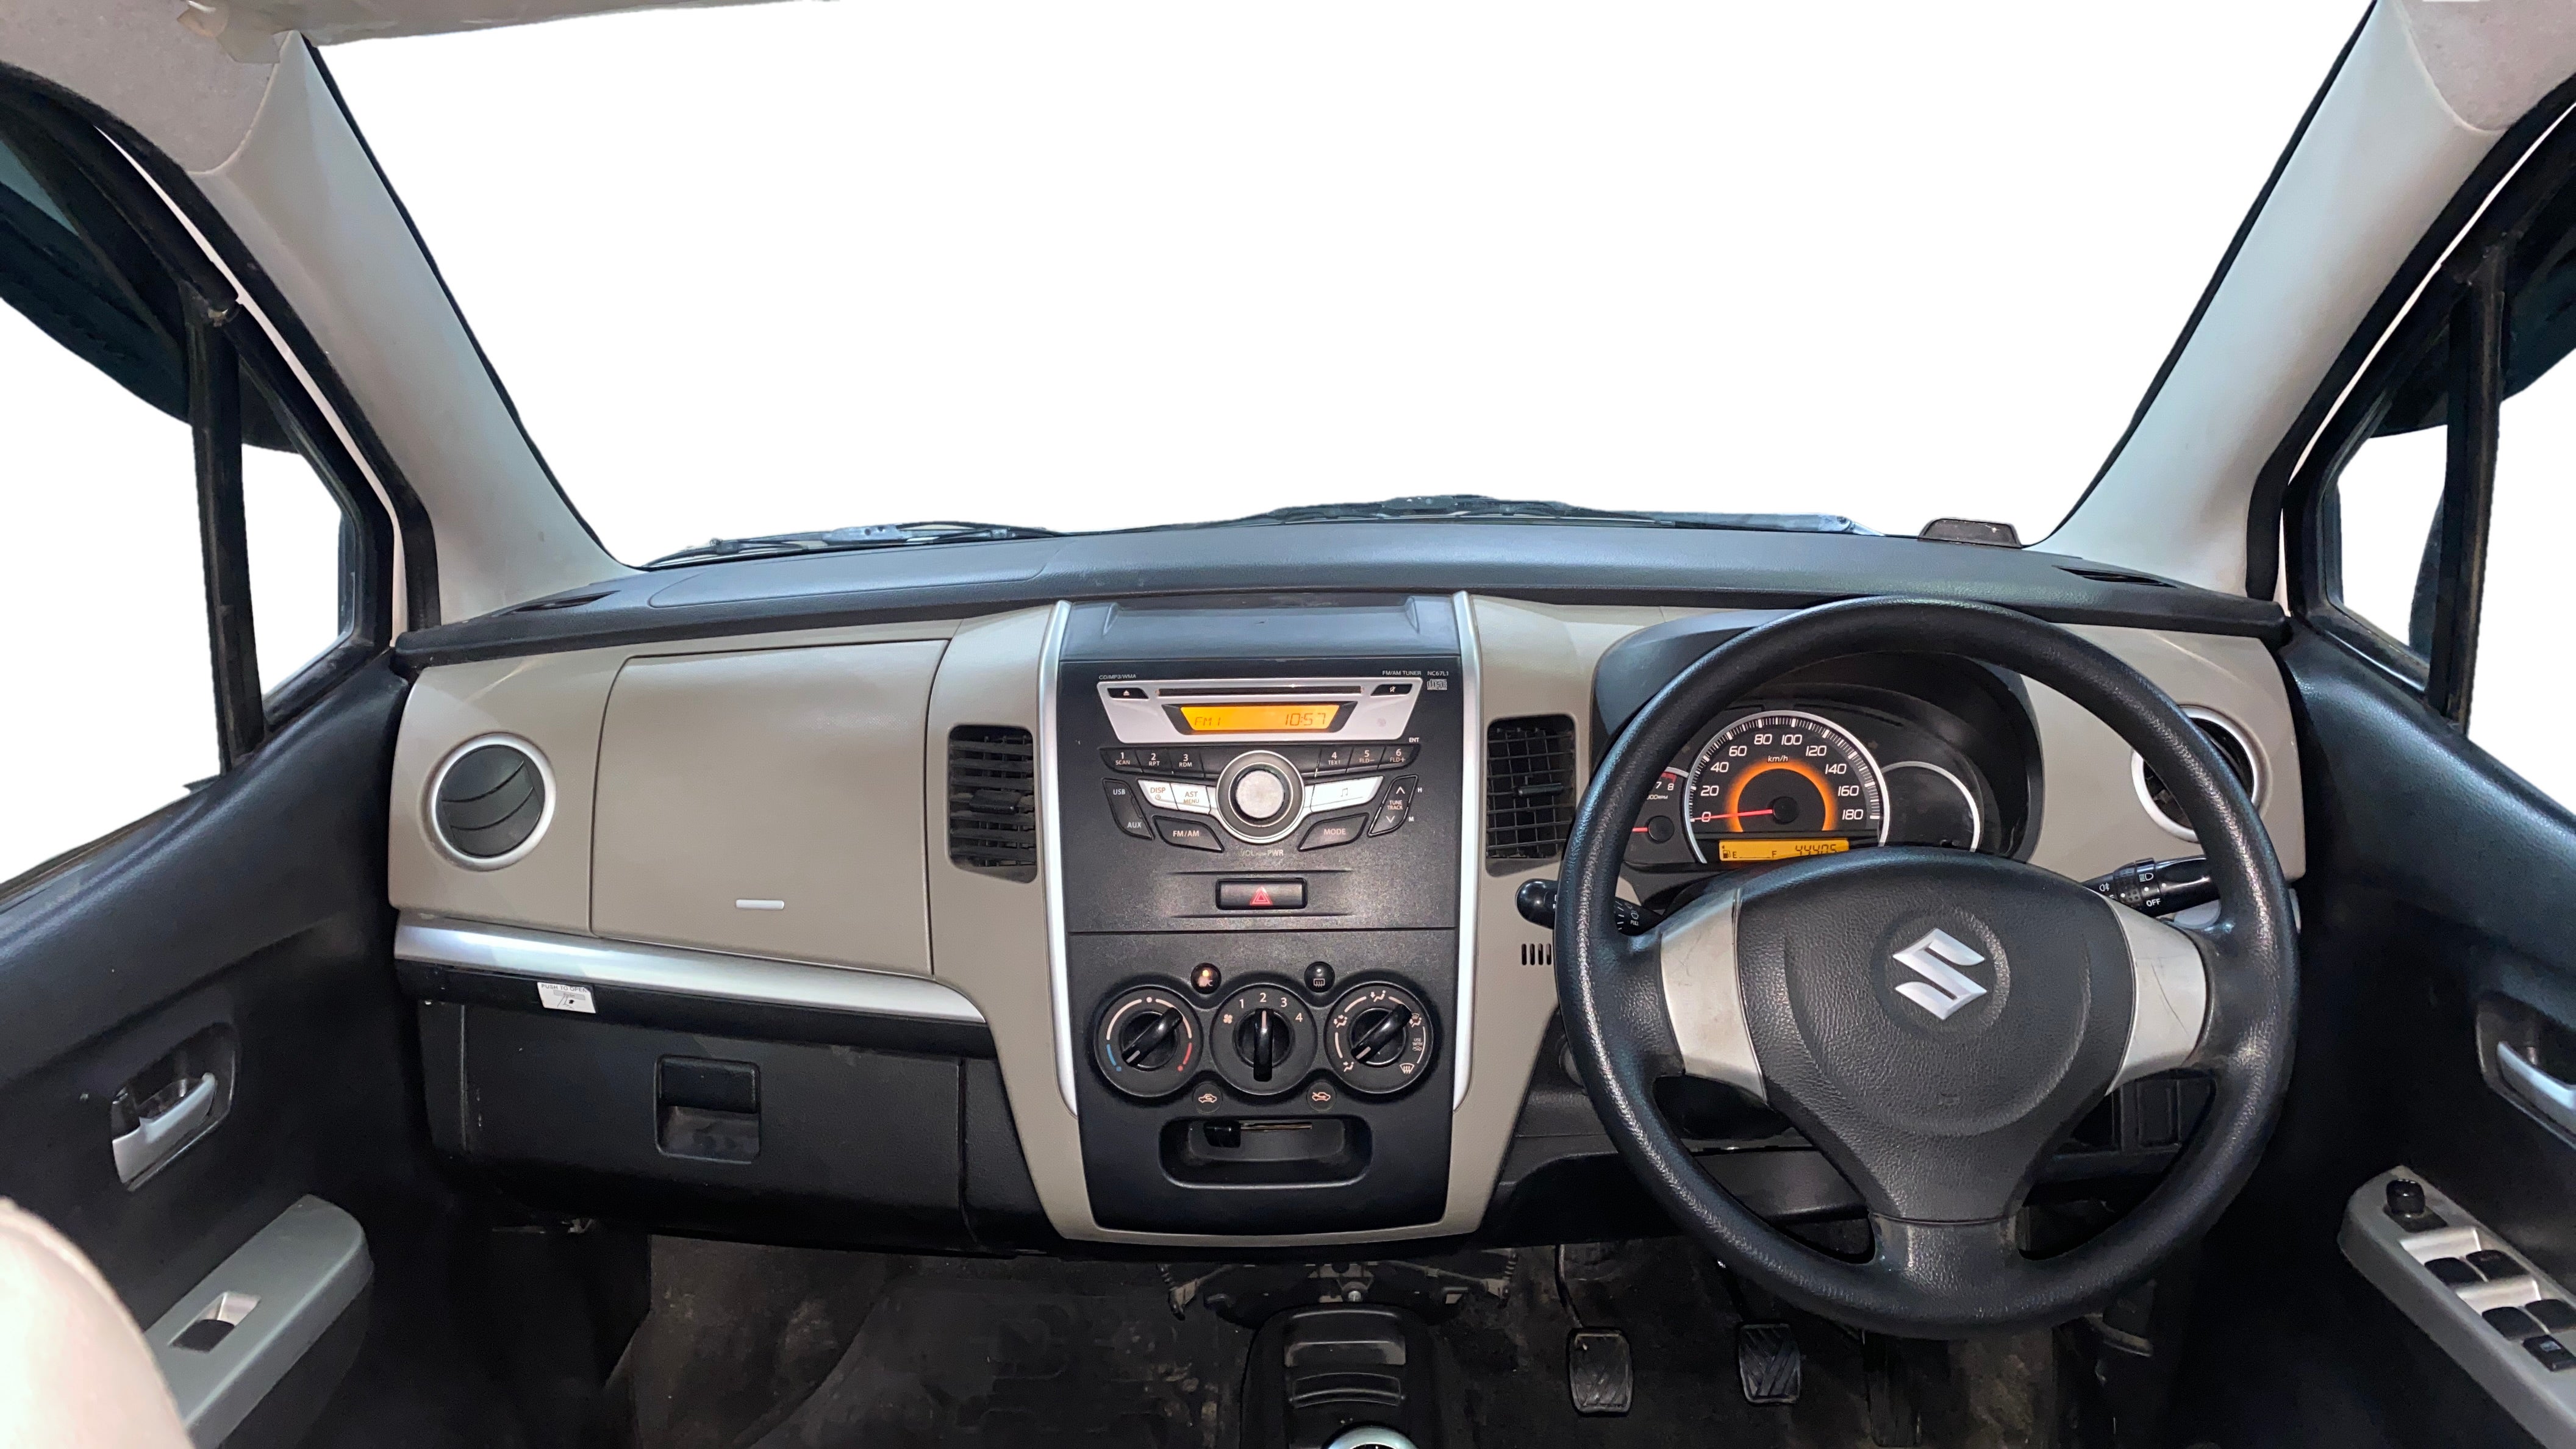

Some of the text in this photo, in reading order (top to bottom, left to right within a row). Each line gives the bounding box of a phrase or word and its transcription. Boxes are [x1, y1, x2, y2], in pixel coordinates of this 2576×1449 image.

[1285, 713, 1326, 726] 10:57
[1754, 734, 1772, 745] 80
[1781, 734, 1802, 745] 100
[1728, 745, 1747, 757] 60
[1805, 745, 1827, 757] 120
[1710, 762, 1729, 773] 40
[1825, 764, 1847, 775] 140
[1700, 785, 1719, 796] 20
[1837, 785, 1859, 796] 160
[1701, 812, 1711, 822] 0
[1842, 809, 1864, 820] 180
[2146, 898, 2161, 907] OFF
[1259, 992, 1267, 1003] 2
[1281, 997, 1287, 1007] 3
[1239, 999, 1245, 1009] 1
[1295, 1012, 1303, 1023] 4
